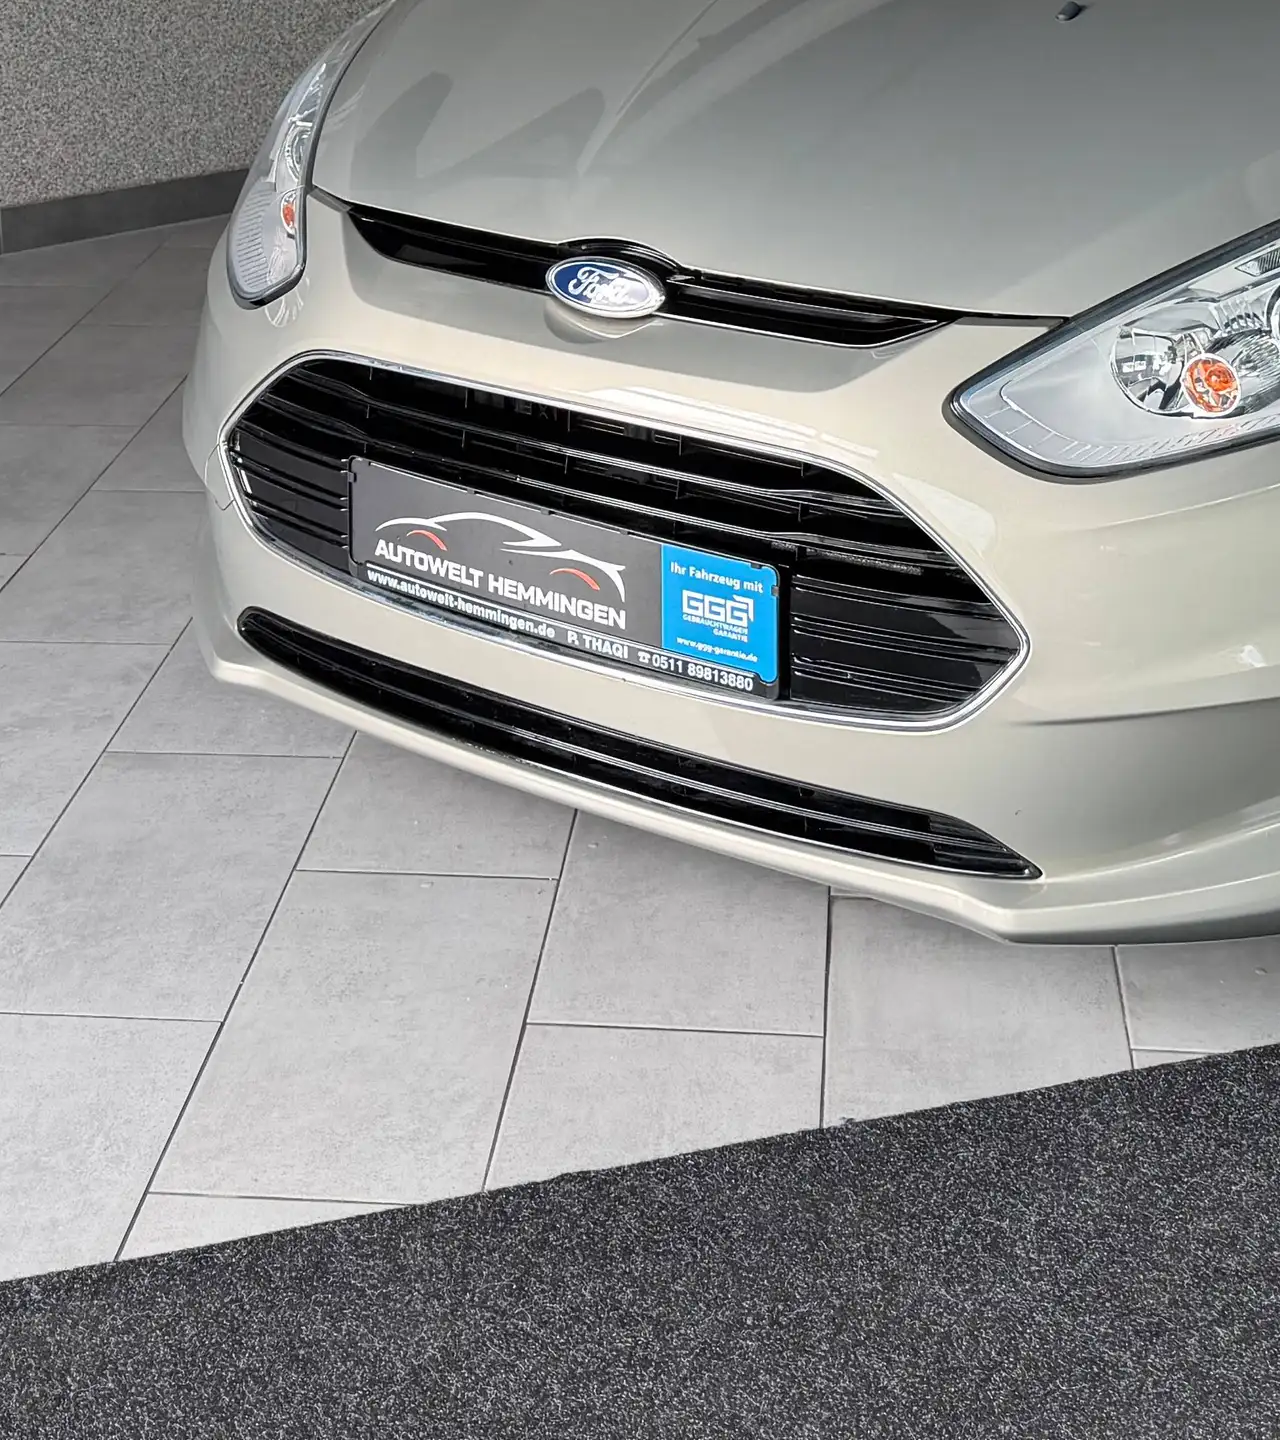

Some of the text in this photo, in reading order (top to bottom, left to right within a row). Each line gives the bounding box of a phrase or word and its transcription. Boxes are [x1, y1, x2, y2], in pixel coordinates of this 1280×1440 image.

[568, 266, 632, 305] Ford
[374, 539, 626, 630] AUTOWELT HEMMINGEN
[670, 562, 764, 593] Ihr Fahrzeug mit
[682, 589, 754, 627] GGG
[366, 569, 556, 639] www.autowelt-hemmingen.de
[583, 635, 629, 659] THAQI
[652, 653, 683, 674] 0511
[687, 662, 754, 692] 89813880
[676, 636, 758, 663] www.ggg-garantie.de
[713, 628, 748, 643] GARANTIE
